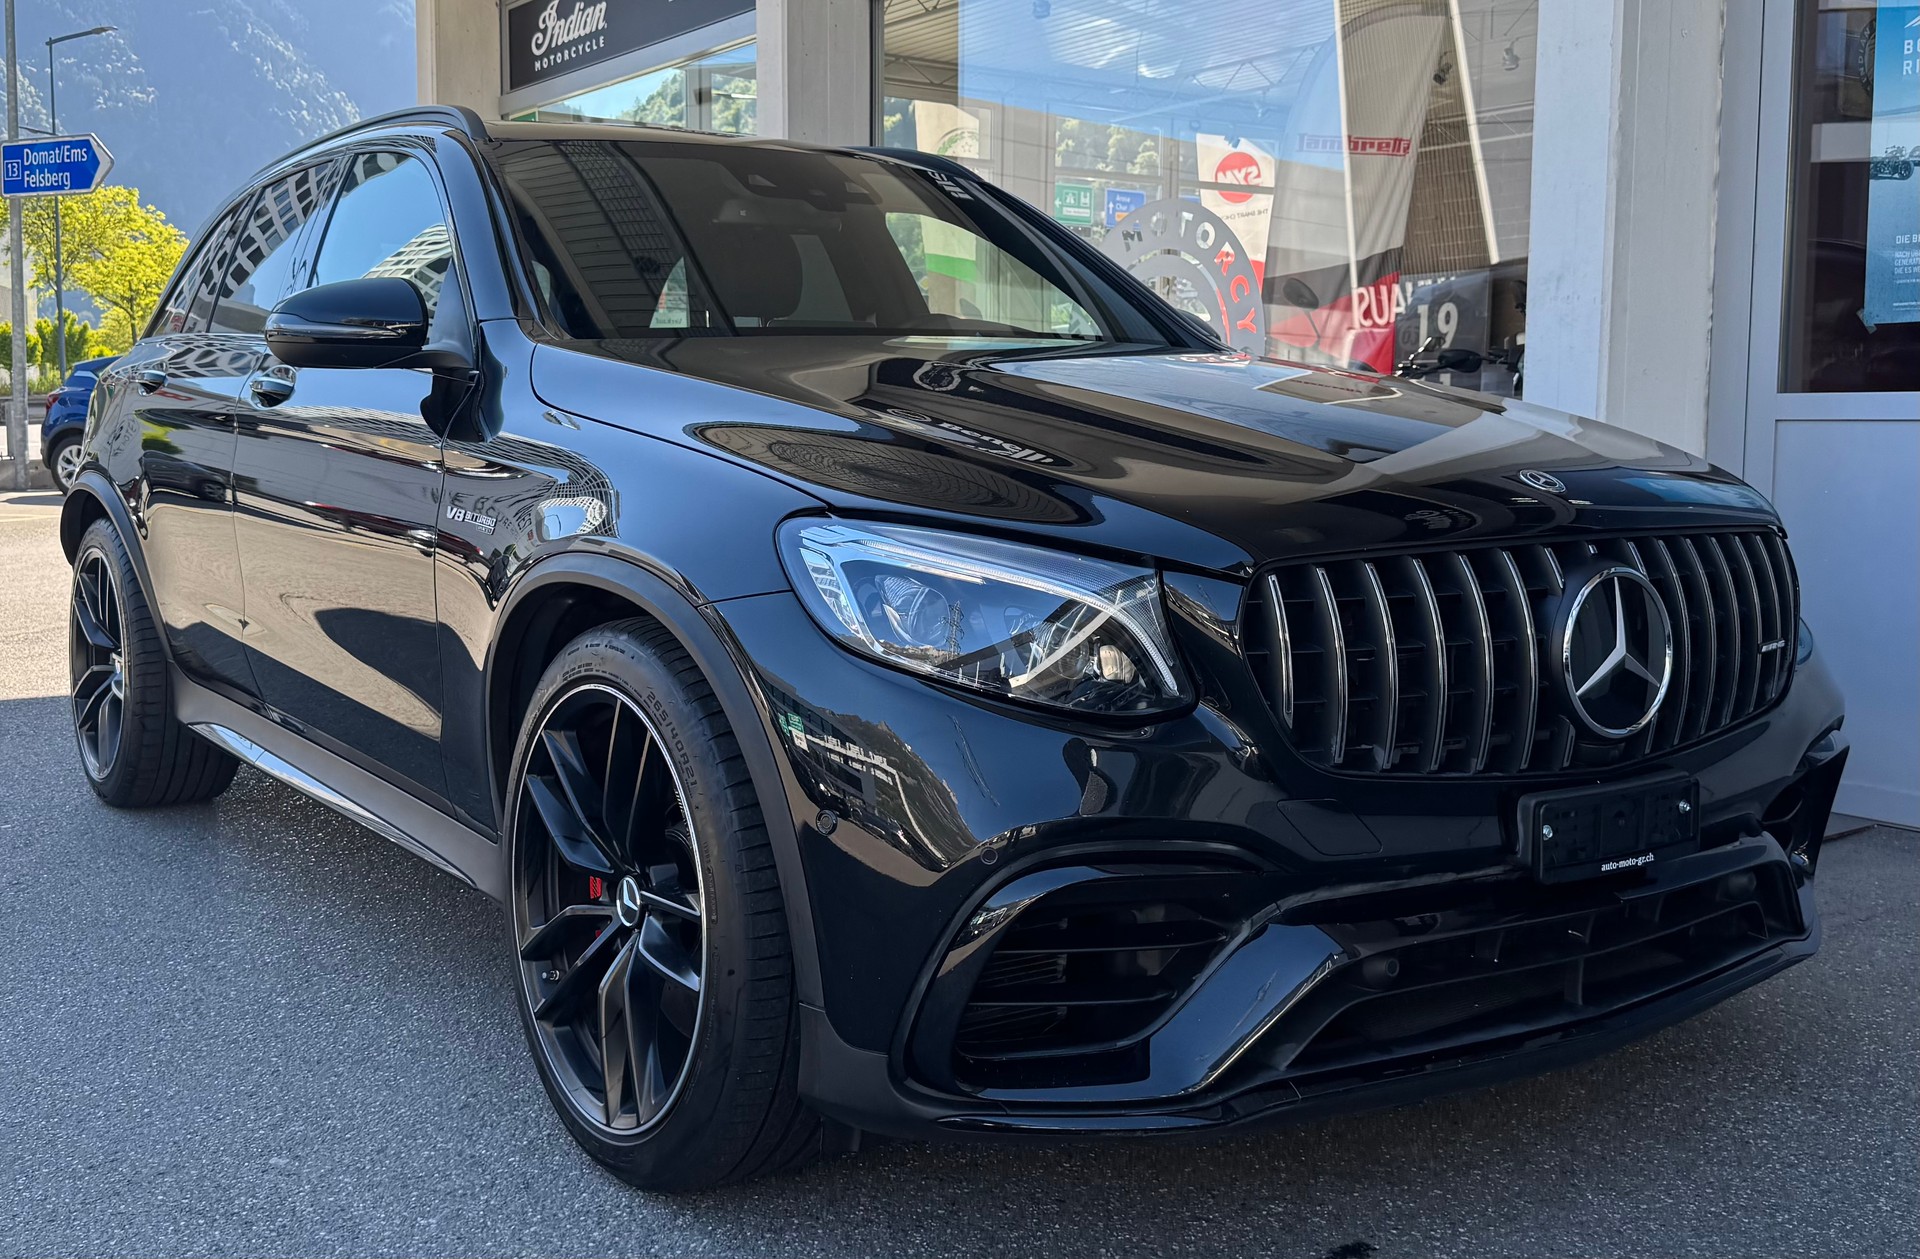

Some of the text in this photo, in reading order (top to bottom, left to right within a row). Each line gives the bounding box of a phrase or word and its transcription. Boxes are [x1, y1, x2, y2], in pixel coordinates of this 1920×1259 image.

[534, 35, 605, 72] MOTORCYCLE
[23, 145, 87, 165] Domat/Ems
[7, 162, 19, 177] 13
[24, 168, 71, 190] Felsberg
[446, 505, 498, 528] V8 BITURBO
[1601, 852, 1655, 871] auto-moto-gr.ch
